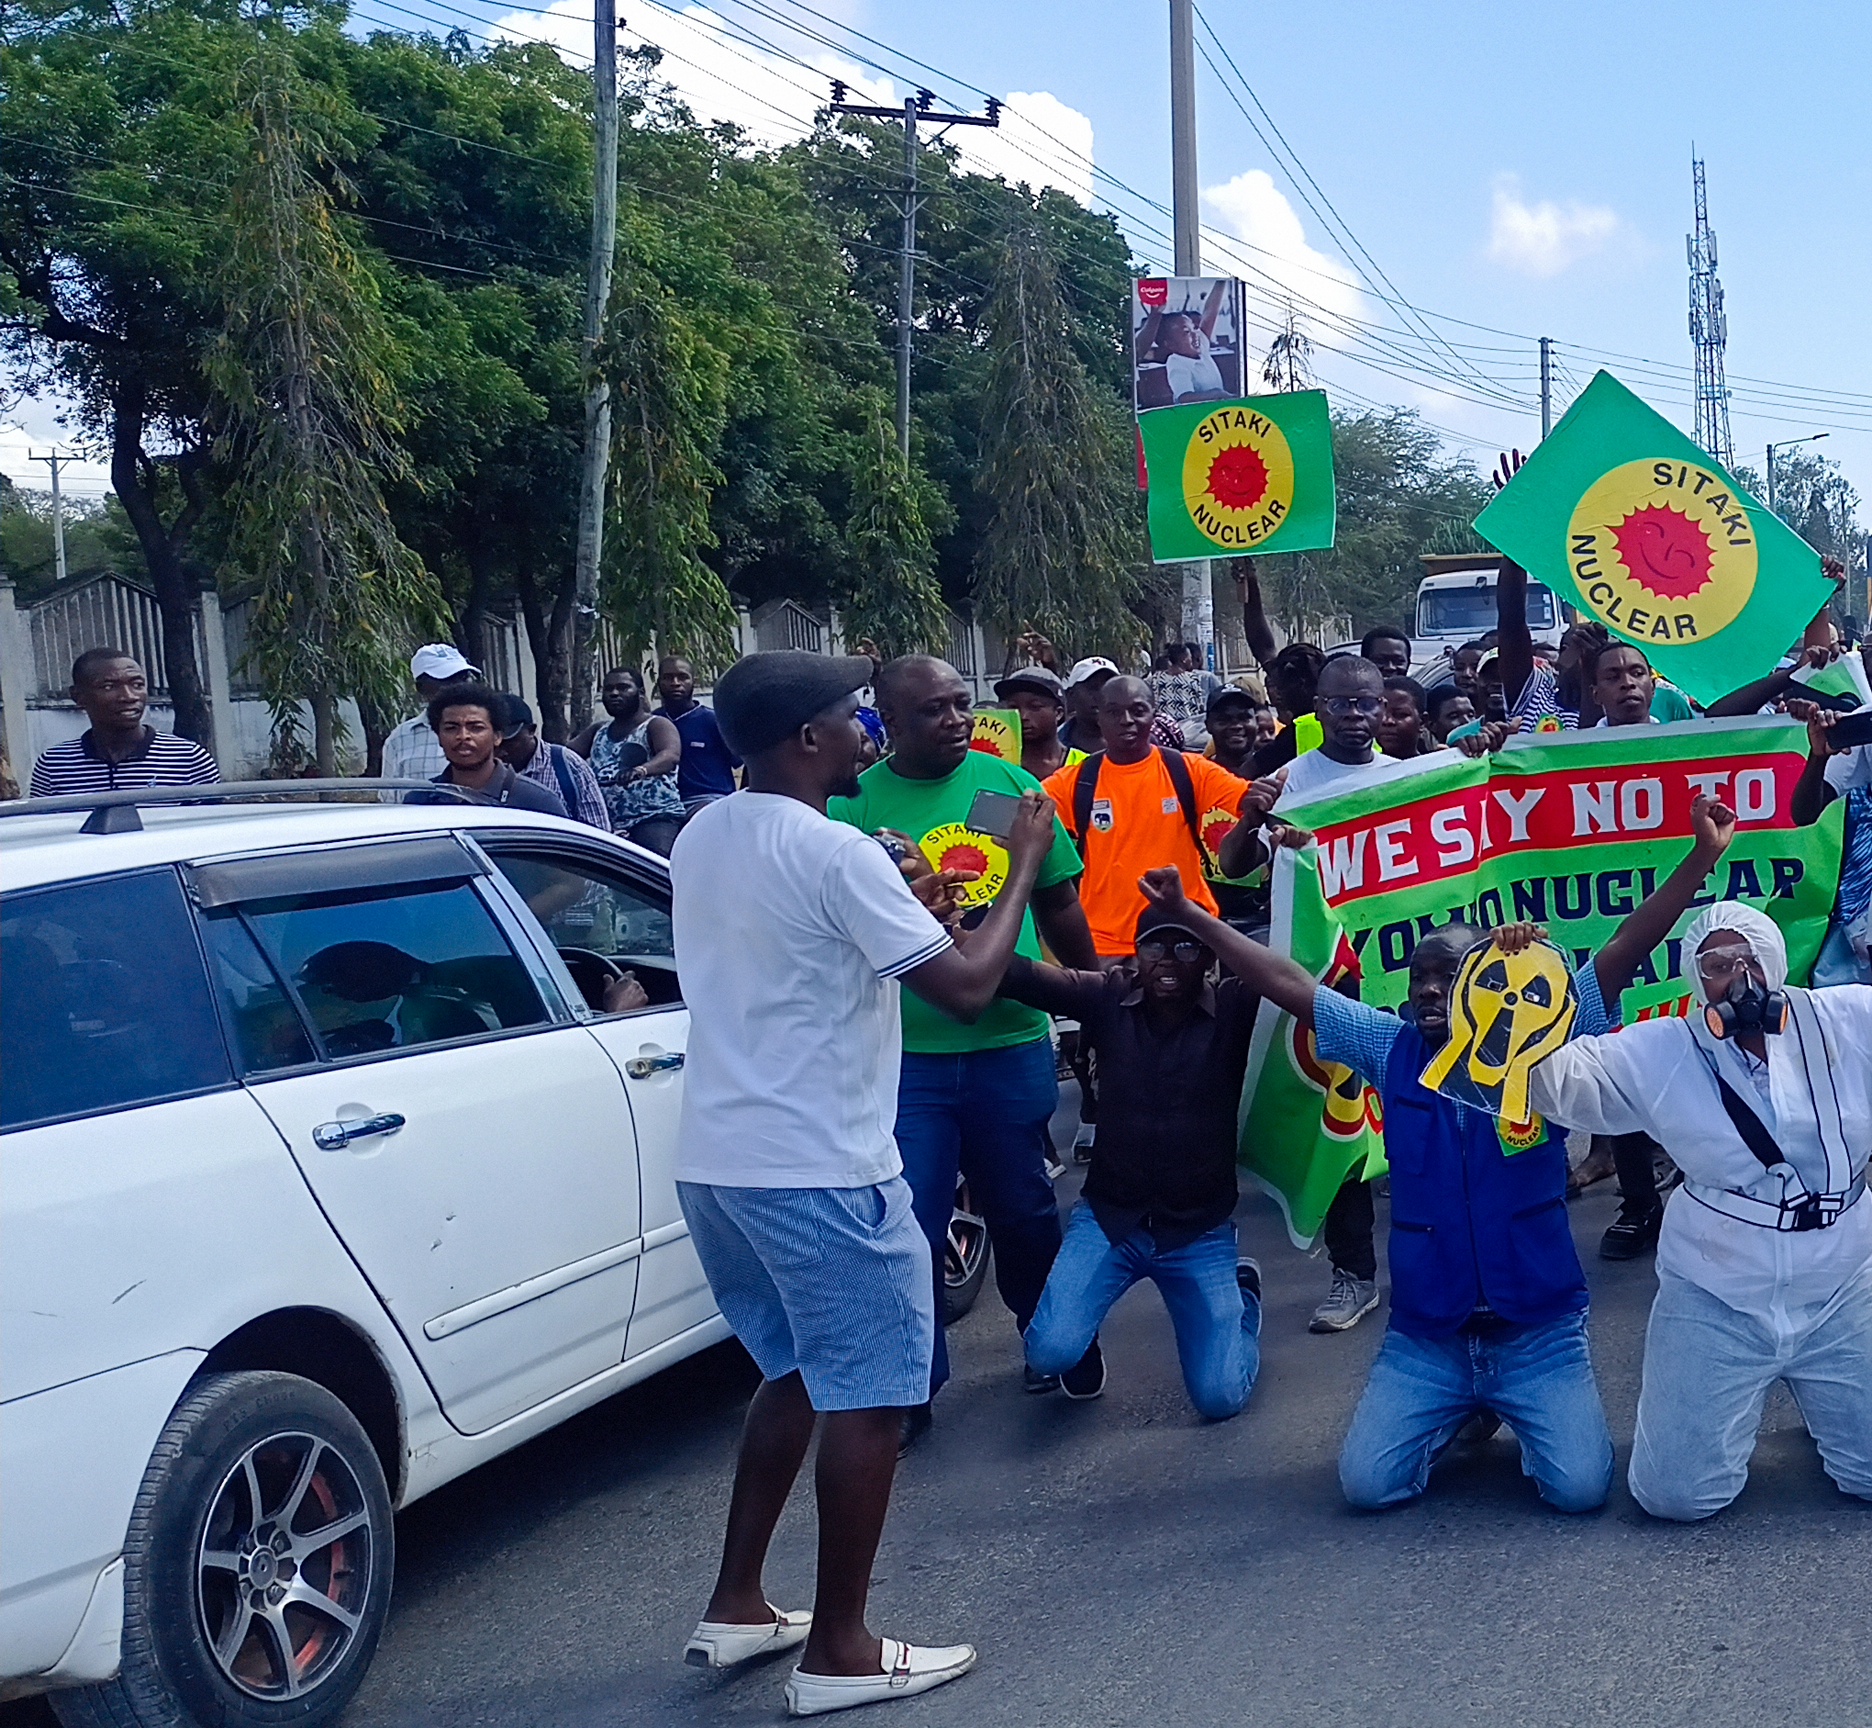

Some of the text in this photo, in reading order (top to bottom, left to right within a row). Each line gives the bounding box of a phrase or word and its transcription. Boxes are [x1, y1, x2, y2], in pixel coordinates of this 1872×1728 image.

[1198, 410, 1271, 444] SITAKI
[1653, 462, 1752, 545] SITAKI
[1193, 499, 1286, 544] NUCLEAR
[1571, 534, 1698, 640] NUCLEAR
[974, 716, 1007, 736] AKI
[926, 824, 982, 845] SITA
[1317, 818, 1420, 900] WE
[1568, 776, 1664, 838] NO
[1684, 767, 1777, 823] TO
[967, 873, 1004, 903] LEAR
[1507, 1126, 1540, 1146] NUCLEAR
